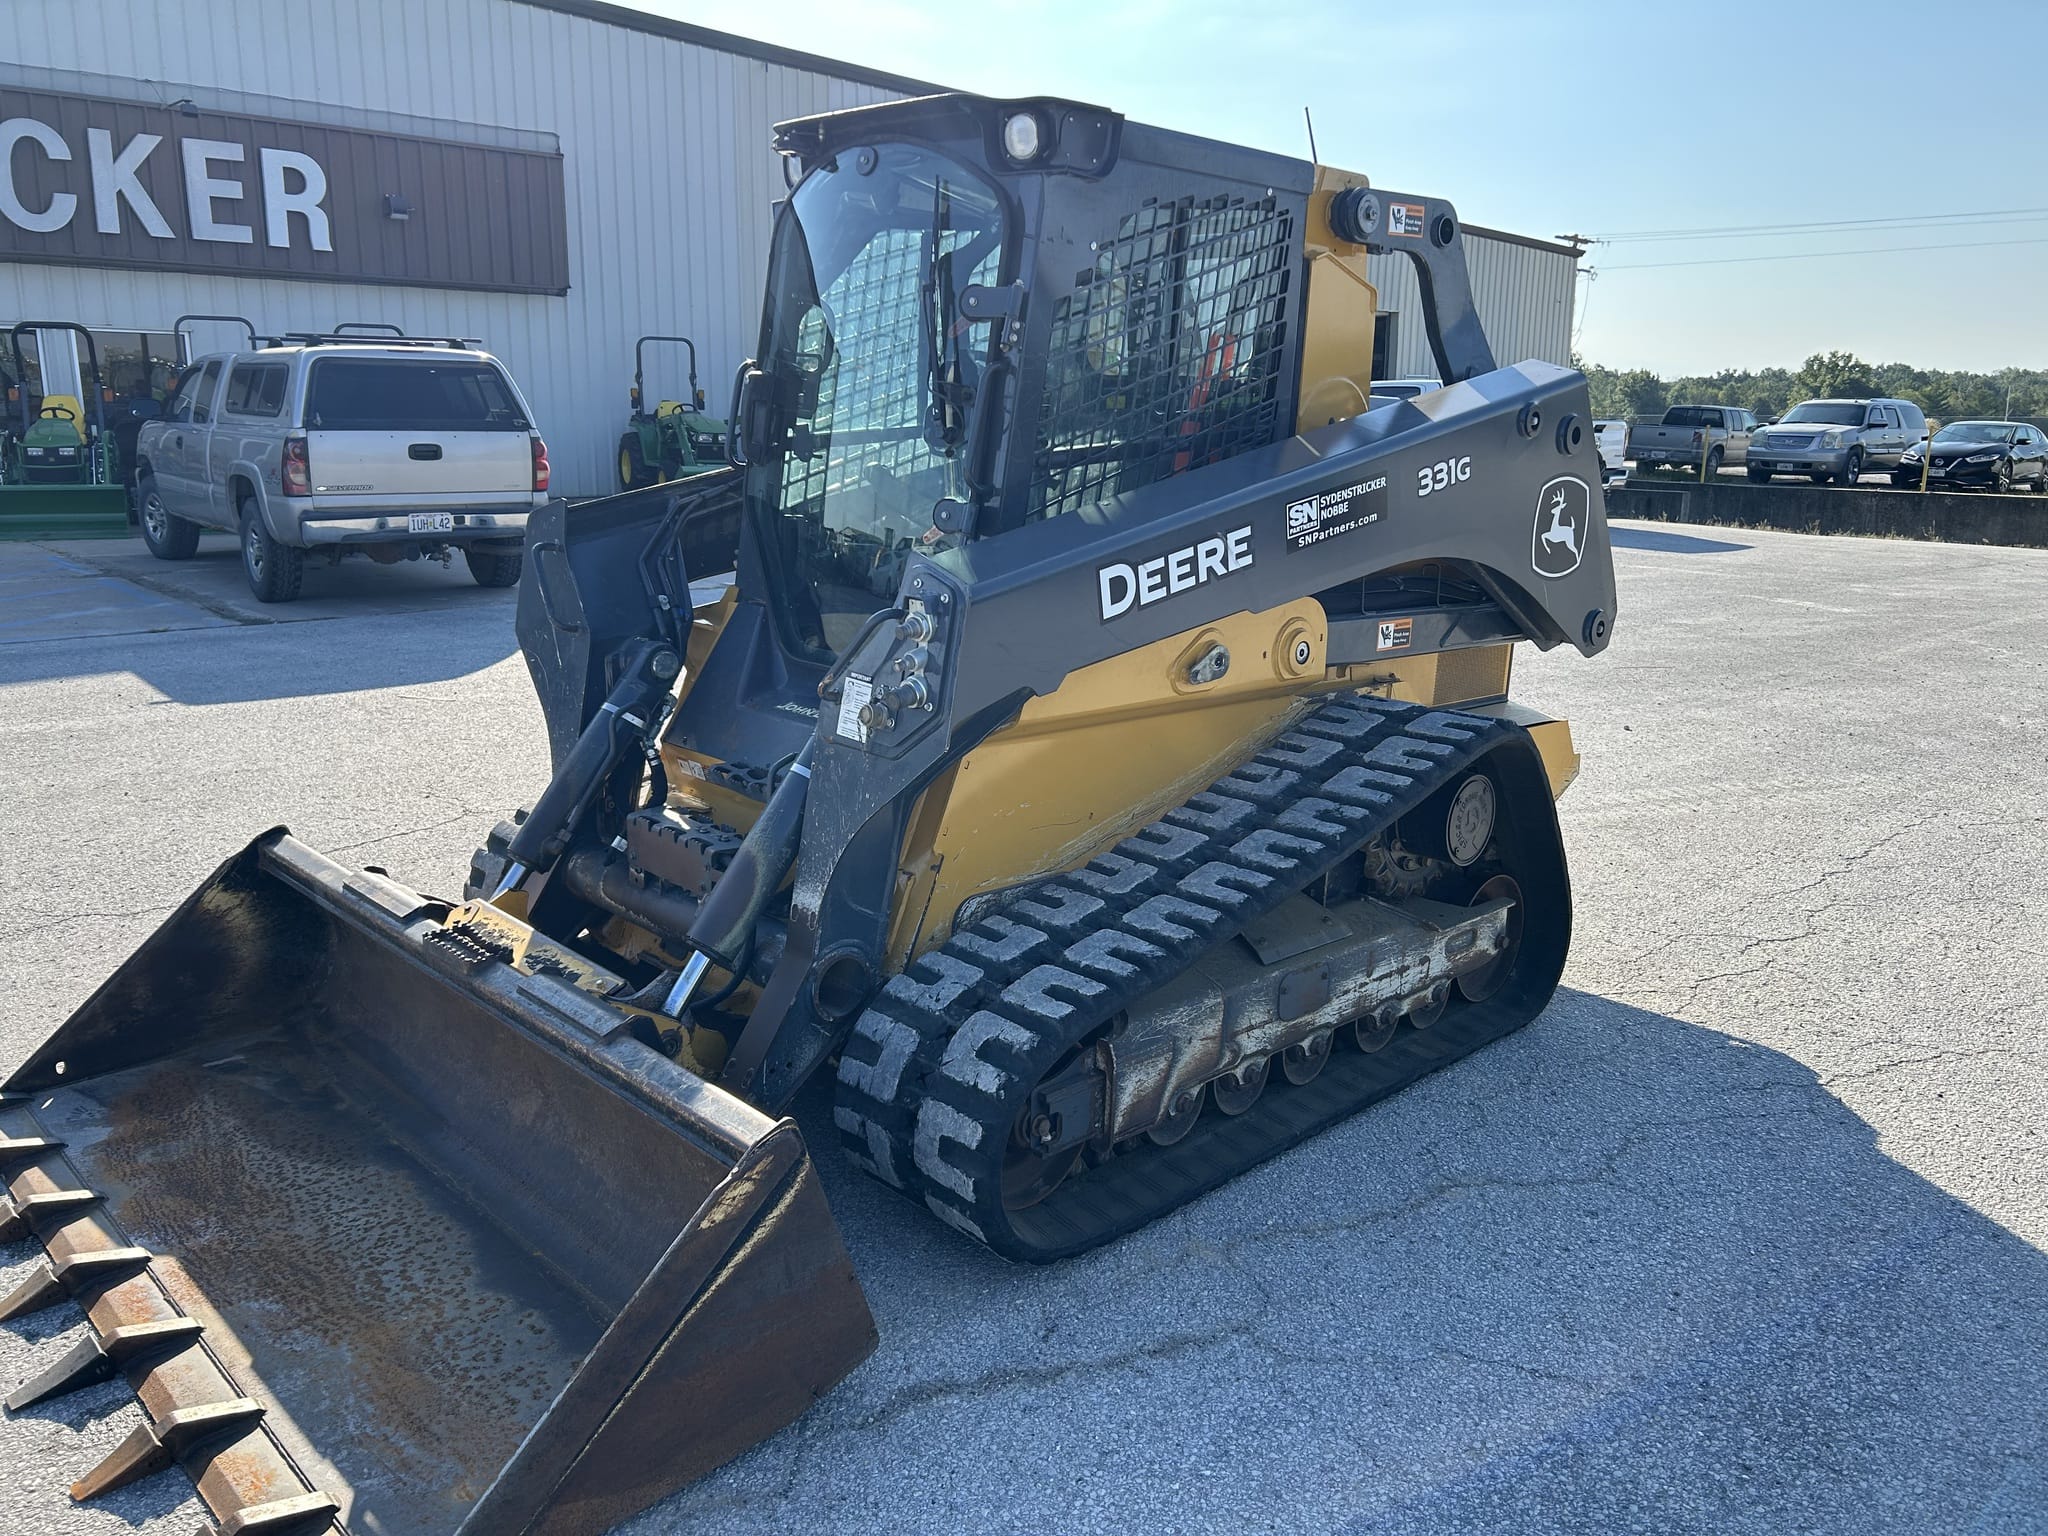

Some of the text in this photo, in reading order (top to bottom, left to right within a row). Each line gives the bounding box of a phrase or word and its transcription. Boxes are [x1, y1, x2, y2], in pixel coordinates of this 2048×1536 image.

[0, 117, 333, 252] CKER
[1320, 476, 1387, 508] SYDENSTRICKER
[1418, 456, 1471, 497] 331G
[1289, 499, 1318, 527] SN
[1289, 520, 1318, 535] PARTNERS
[1320, 501, 1350, 521] NOBBE
[1298, 513, 1378, 547] SNPartners.com
[1099, 525, 1253, 620] DEERE
